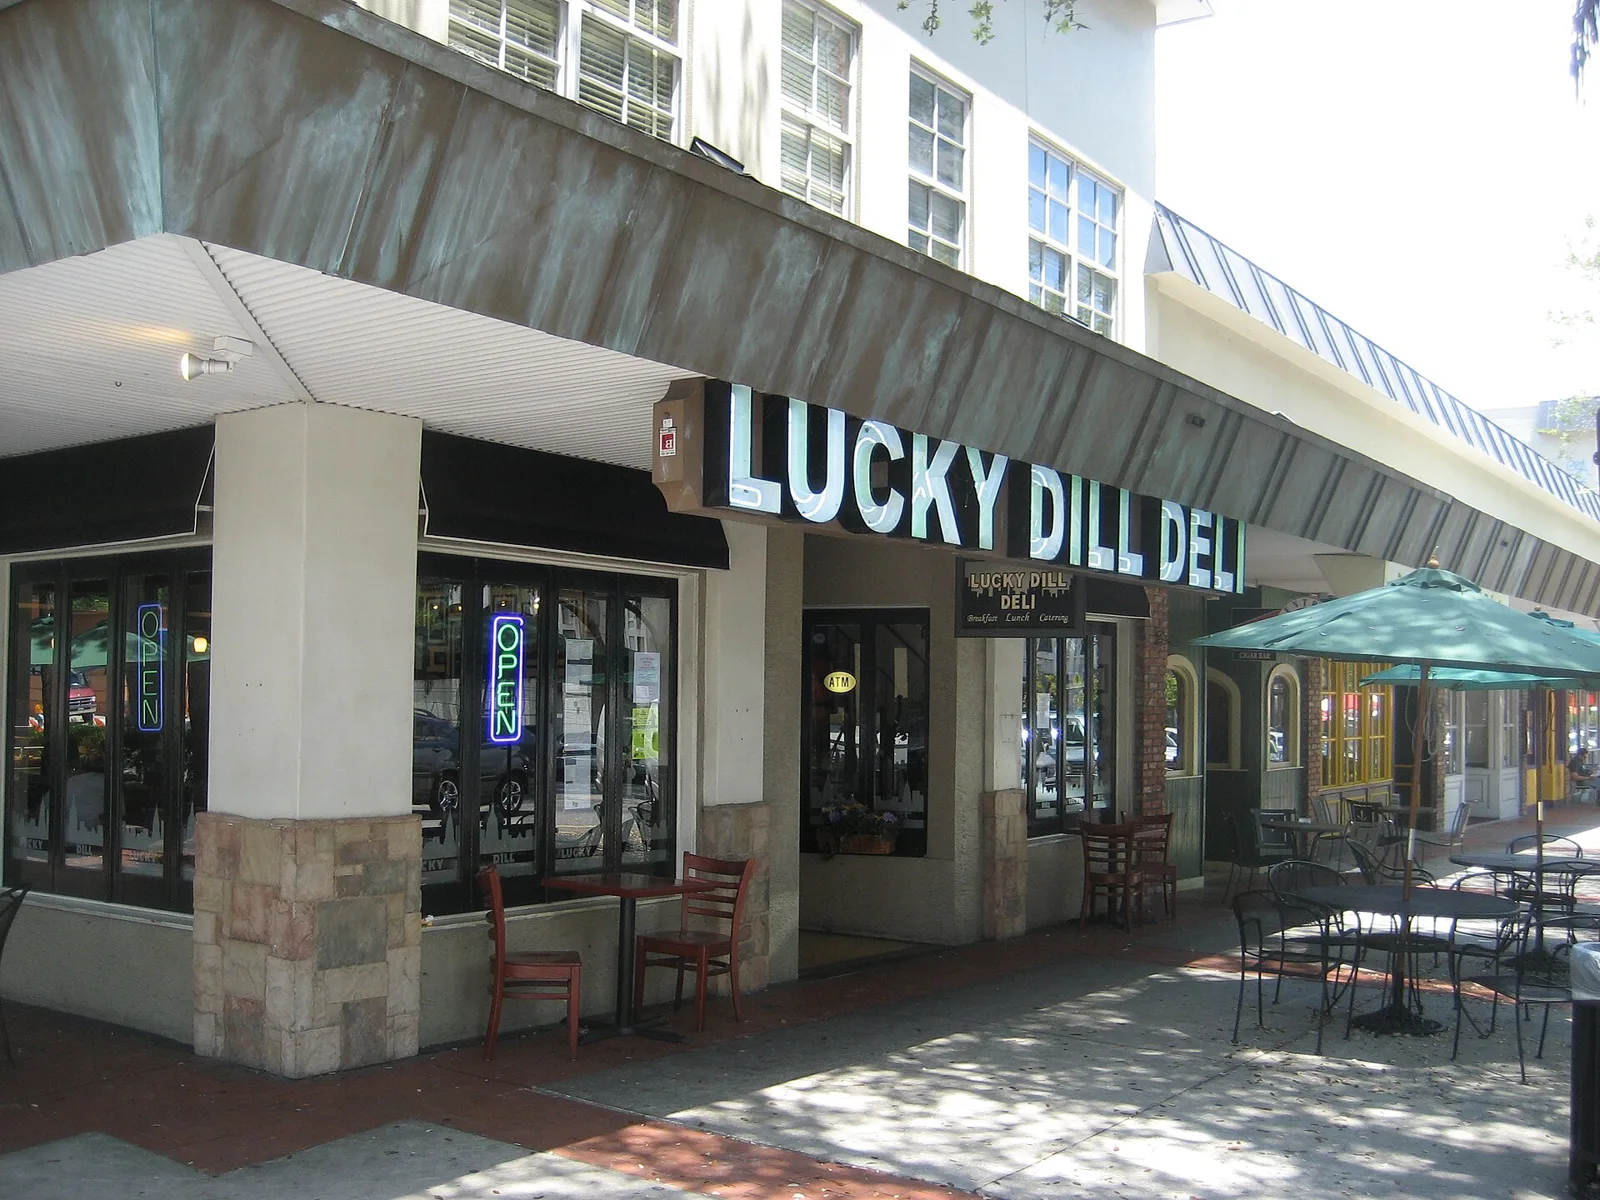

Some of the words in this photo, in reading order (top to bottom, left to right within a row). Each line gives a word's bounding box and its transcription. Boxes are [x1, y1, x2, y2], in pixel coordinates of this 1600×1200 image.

[730, 383, 1008, 550] LUCKY
[1030, 463, 1143, 576] DILL
[1159, 499, 1245, 594] DELI
[970, 573, 1025, 588] LUCKY
[1030, 572, 1067, 588] DILL
[1001, 594, 1035, 610] DELI
[967, 613, 998, 624] Breakfast
[1005, 612, 1030, 622] Lunch
[1039, 613, 1069, 624] Catering
[142, 611, 159, 725] OPEN
[495, 623, 519, 736] OPEN
[829, 676, 849, 687] ATM
[493, 852, 515, 864] DILL
[561, 846, 593, 859] LUCKY
